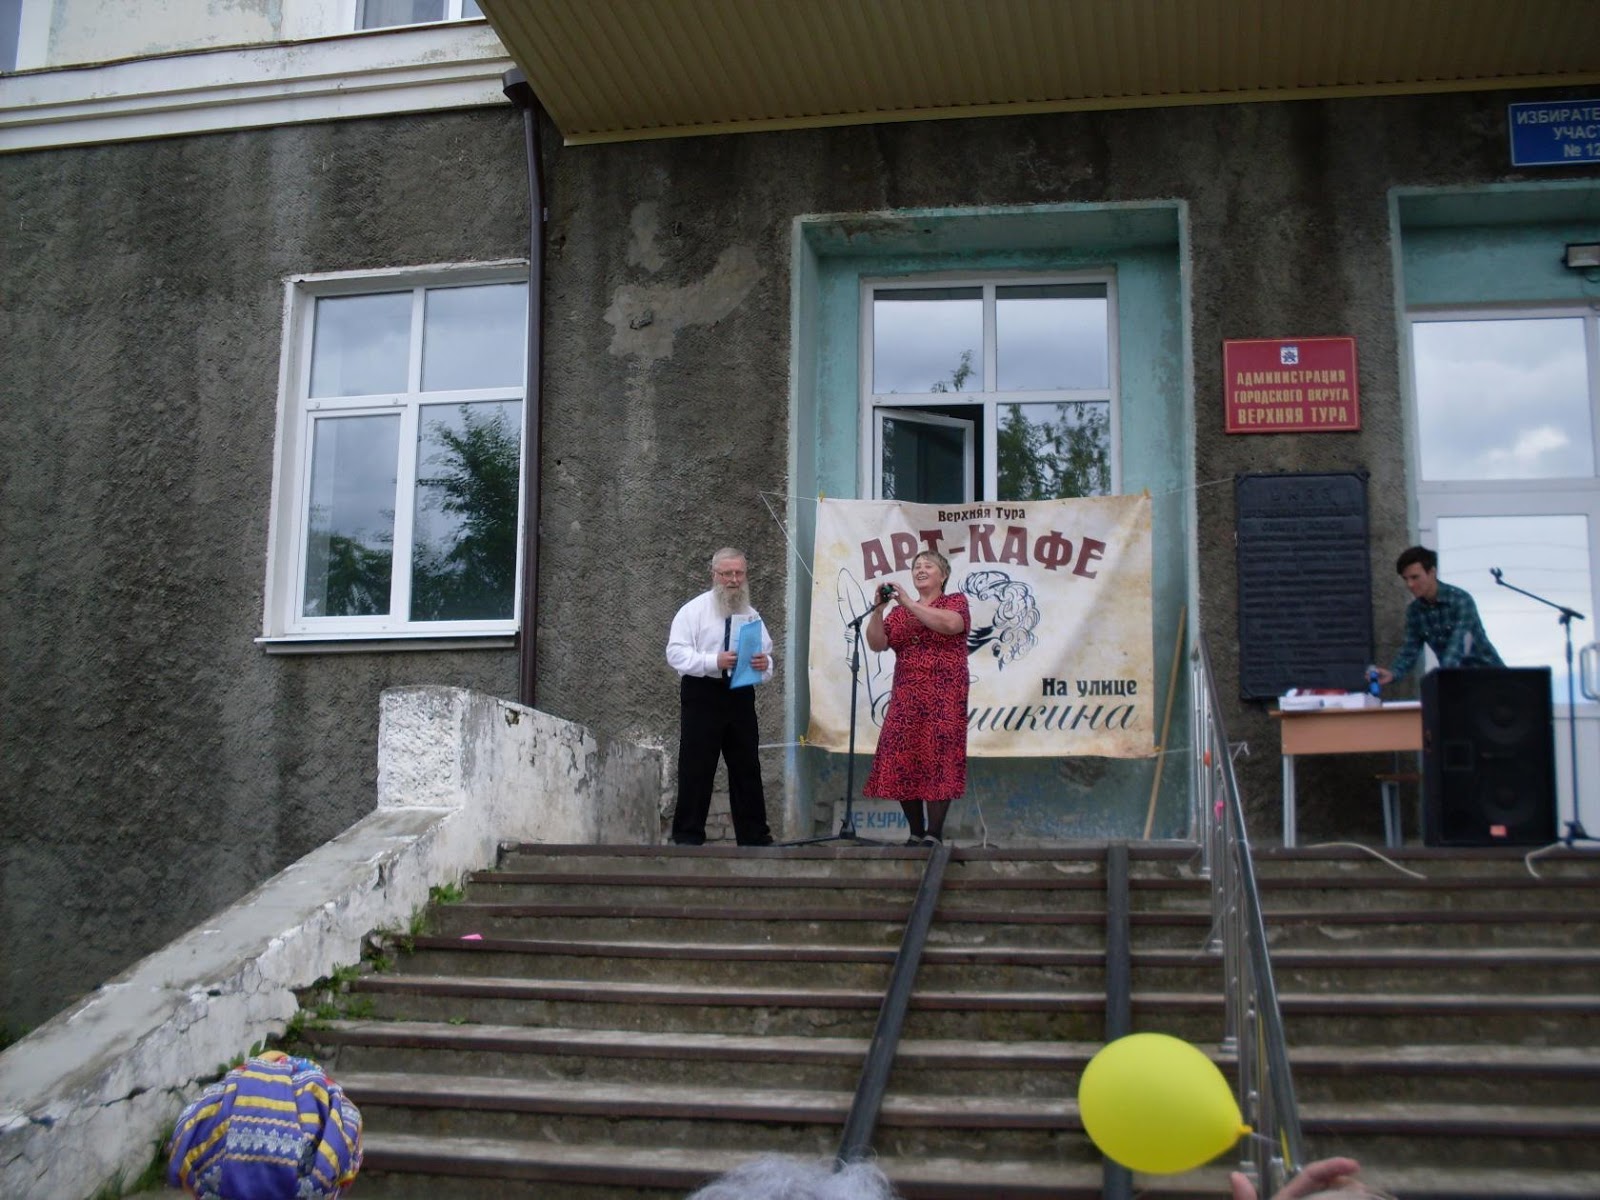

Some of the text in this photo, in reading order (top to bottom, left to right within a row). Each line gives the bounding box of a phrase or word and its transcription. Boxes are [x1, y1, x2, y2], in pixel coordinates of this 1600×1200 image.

[1563, 144, 1582, 158] №
[1237, 369, 1346, 386] АДМИНИСТРАЦИЯ
[1234, 388, 1349, 404] ГОРОДСКОГО ОКРУГА
[1238, 407, 1348, 424] ВЕРХНЯЯ ТУРА
[938, 507, 1026, 522] Верхняя Тура
[860, 524, 1107, 581] АРТ-КАФЕ
[1042, 677, 1137, 698] На улице
